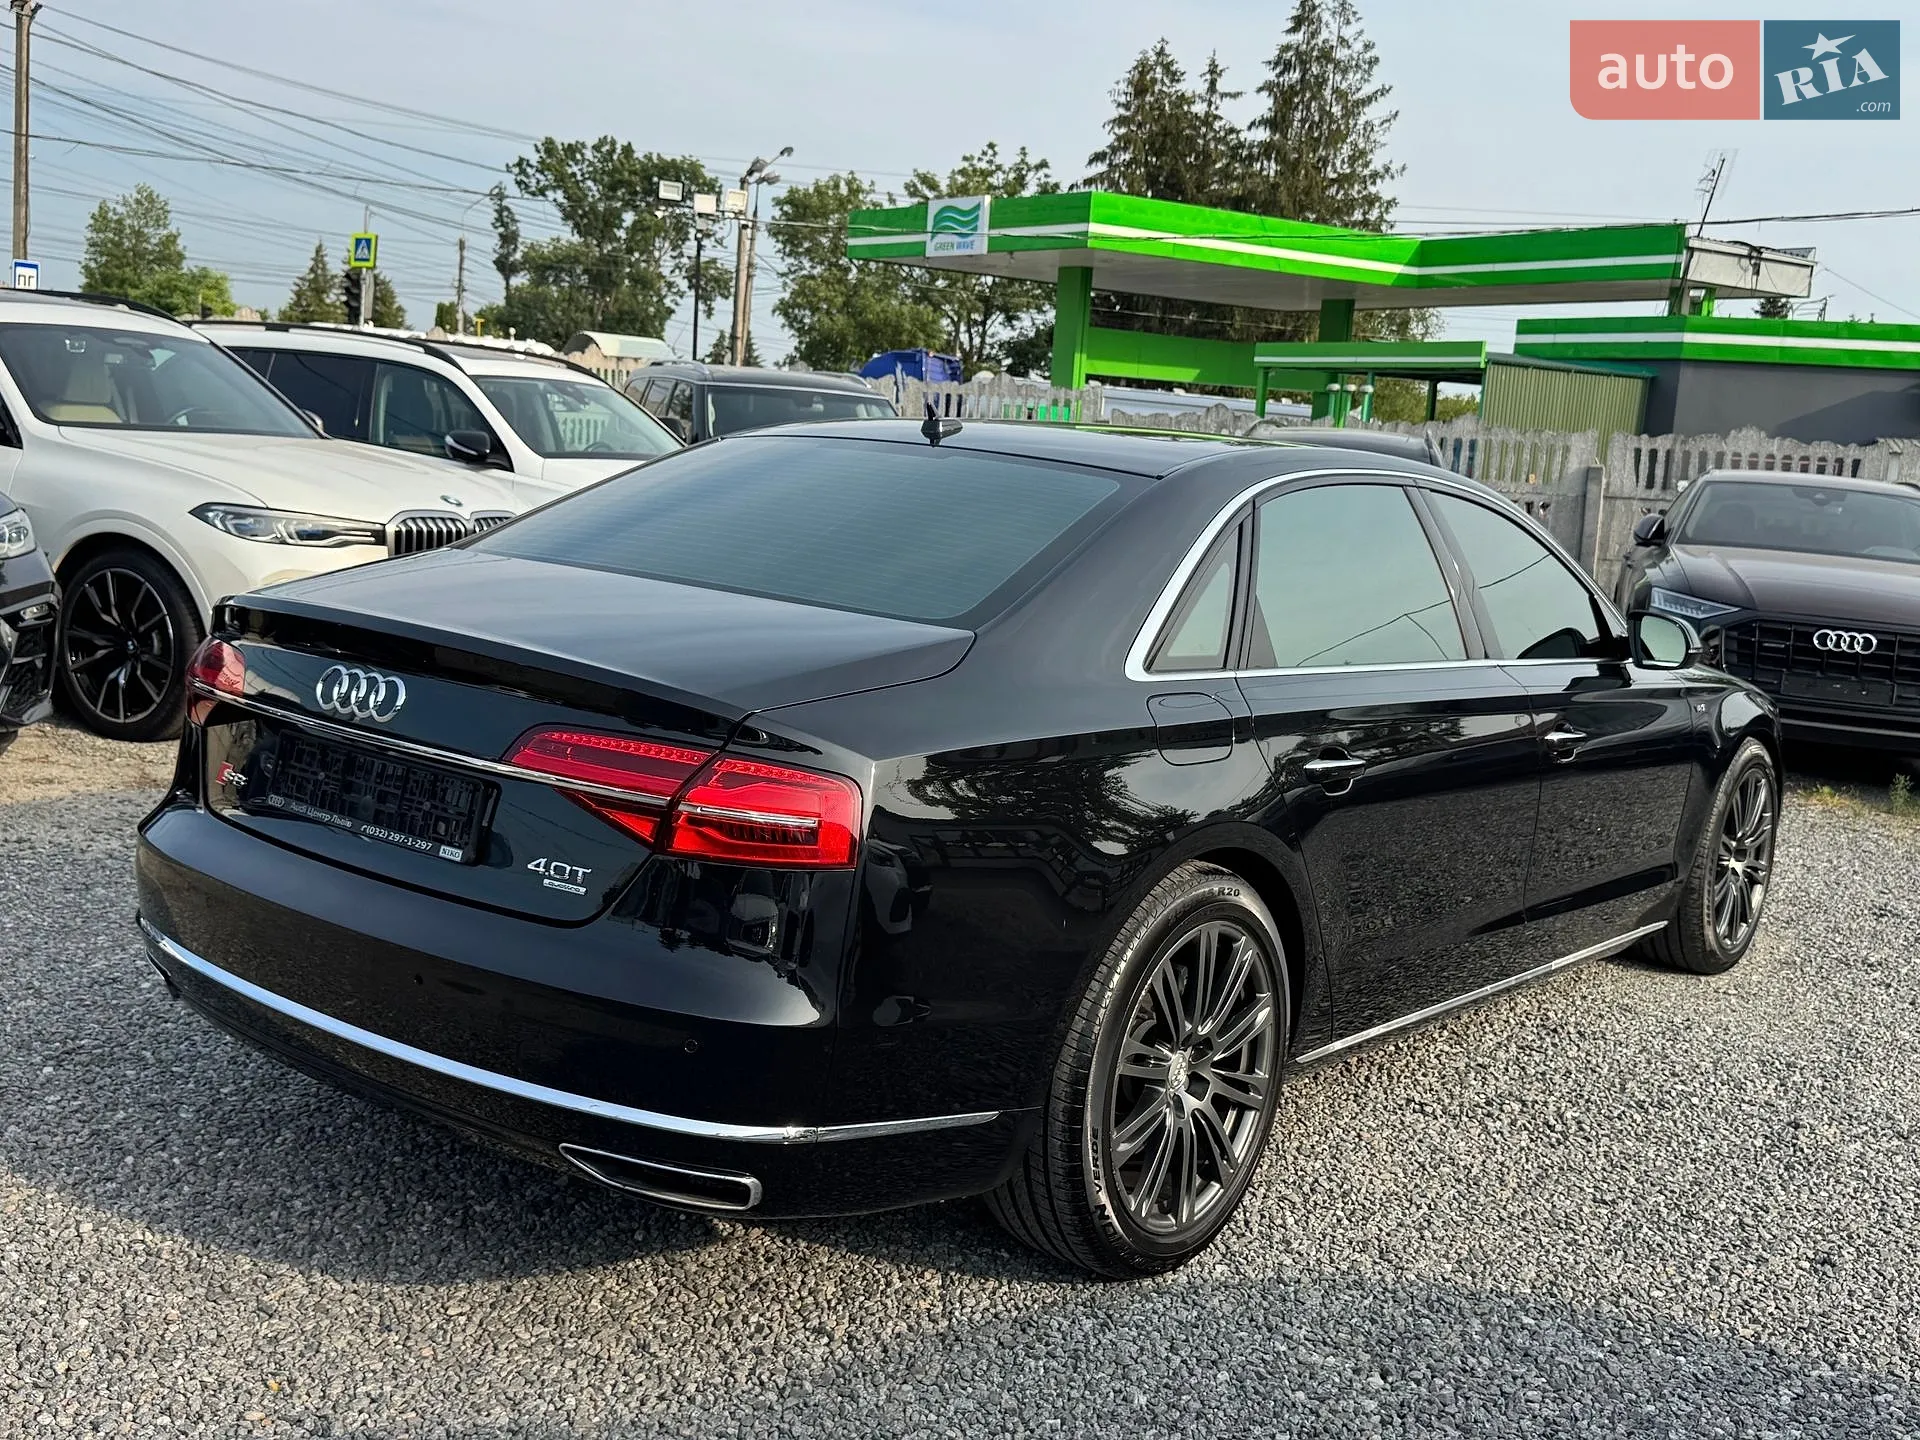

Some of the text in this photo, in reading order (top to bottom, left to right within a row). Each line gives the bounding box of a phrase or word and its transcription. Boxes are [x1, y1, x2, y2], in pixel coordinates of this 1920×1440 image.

[934, 241, 955, 251] GREEN
[290, 802, 433, 851] Audi Центр Львів (032) 297-1-297
[440, 847, 461, 859] NIKO
[527, 858, 592, 884] 4.0T
[1217, 886, 1240, 897] R20
[1091, 1126, 1103, 1195] VERDE
